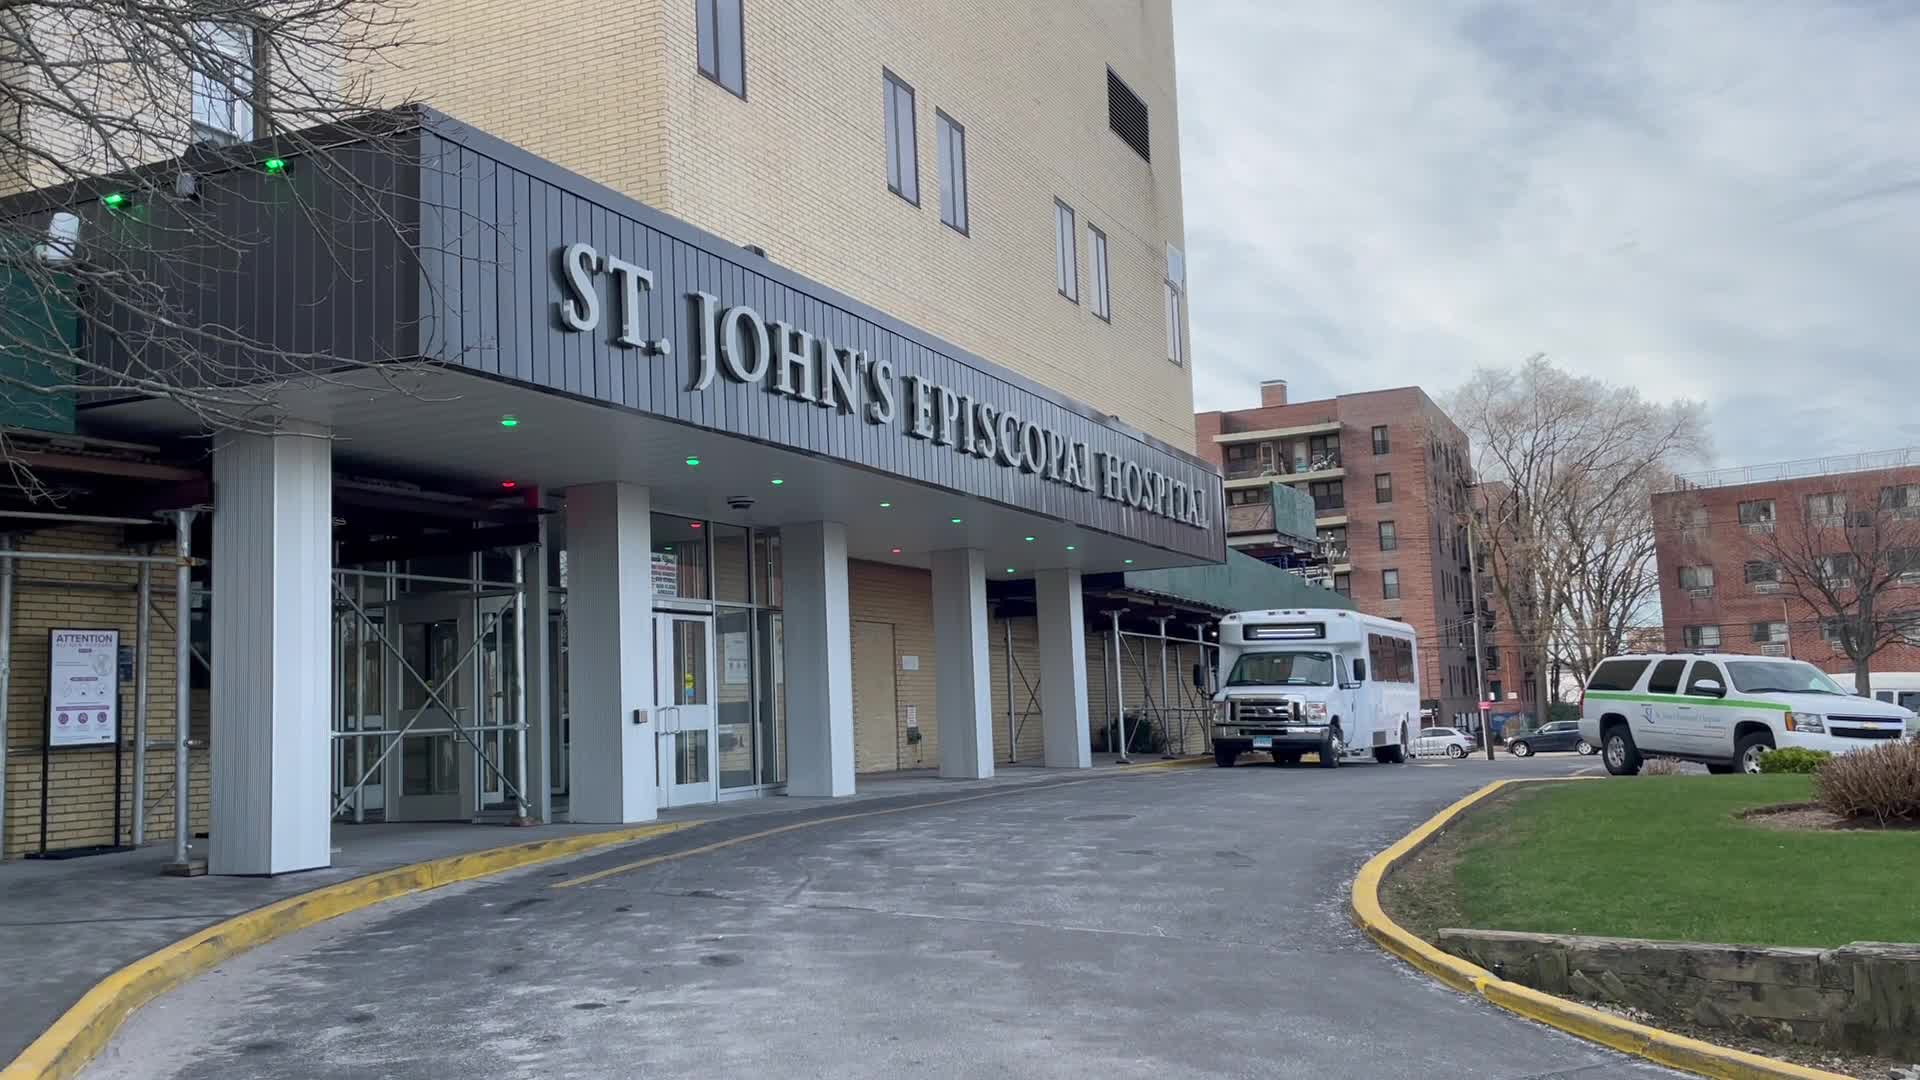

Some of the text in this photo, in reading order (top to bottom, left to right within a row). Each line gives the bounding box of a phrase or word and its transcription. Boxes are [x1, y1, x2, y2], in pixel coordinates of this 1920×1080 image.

[559, 243, 1210, 530] ST. JOHN'S EPISCOPAL HOSPITAL
[56, 634, 112, 642] ATTENTION
